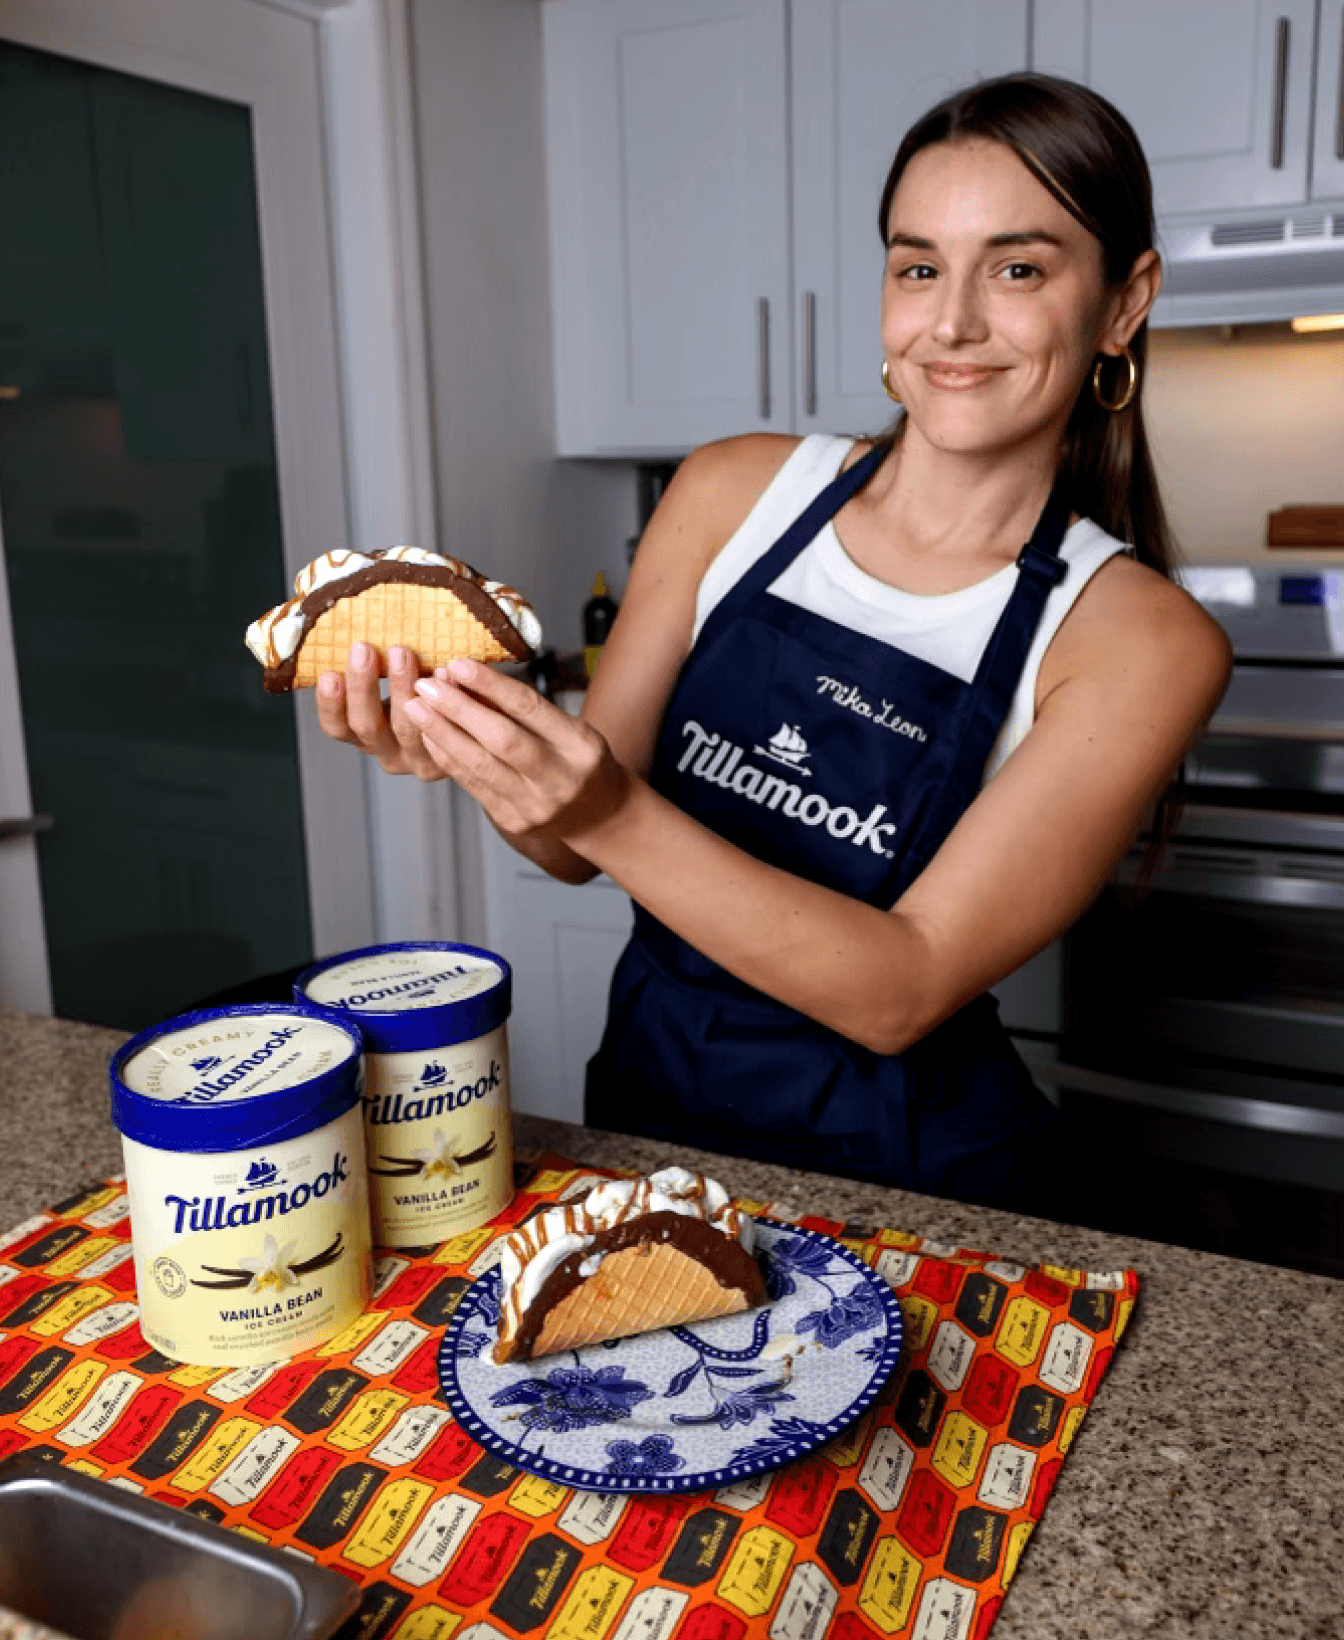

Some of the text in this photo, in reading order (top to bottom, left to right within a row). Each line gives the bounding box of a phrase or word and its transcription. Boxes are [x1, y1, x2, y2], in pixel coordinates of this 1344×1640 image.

[676, 720, 897, 855] Tillamook
[164, 1151, 348, 1234] Tillamook
[218, 1301, 284, 1323] VANILLA
[286, 1286, 324, 1311] BEAN
[244, 1320, 264, 1331] ICE
